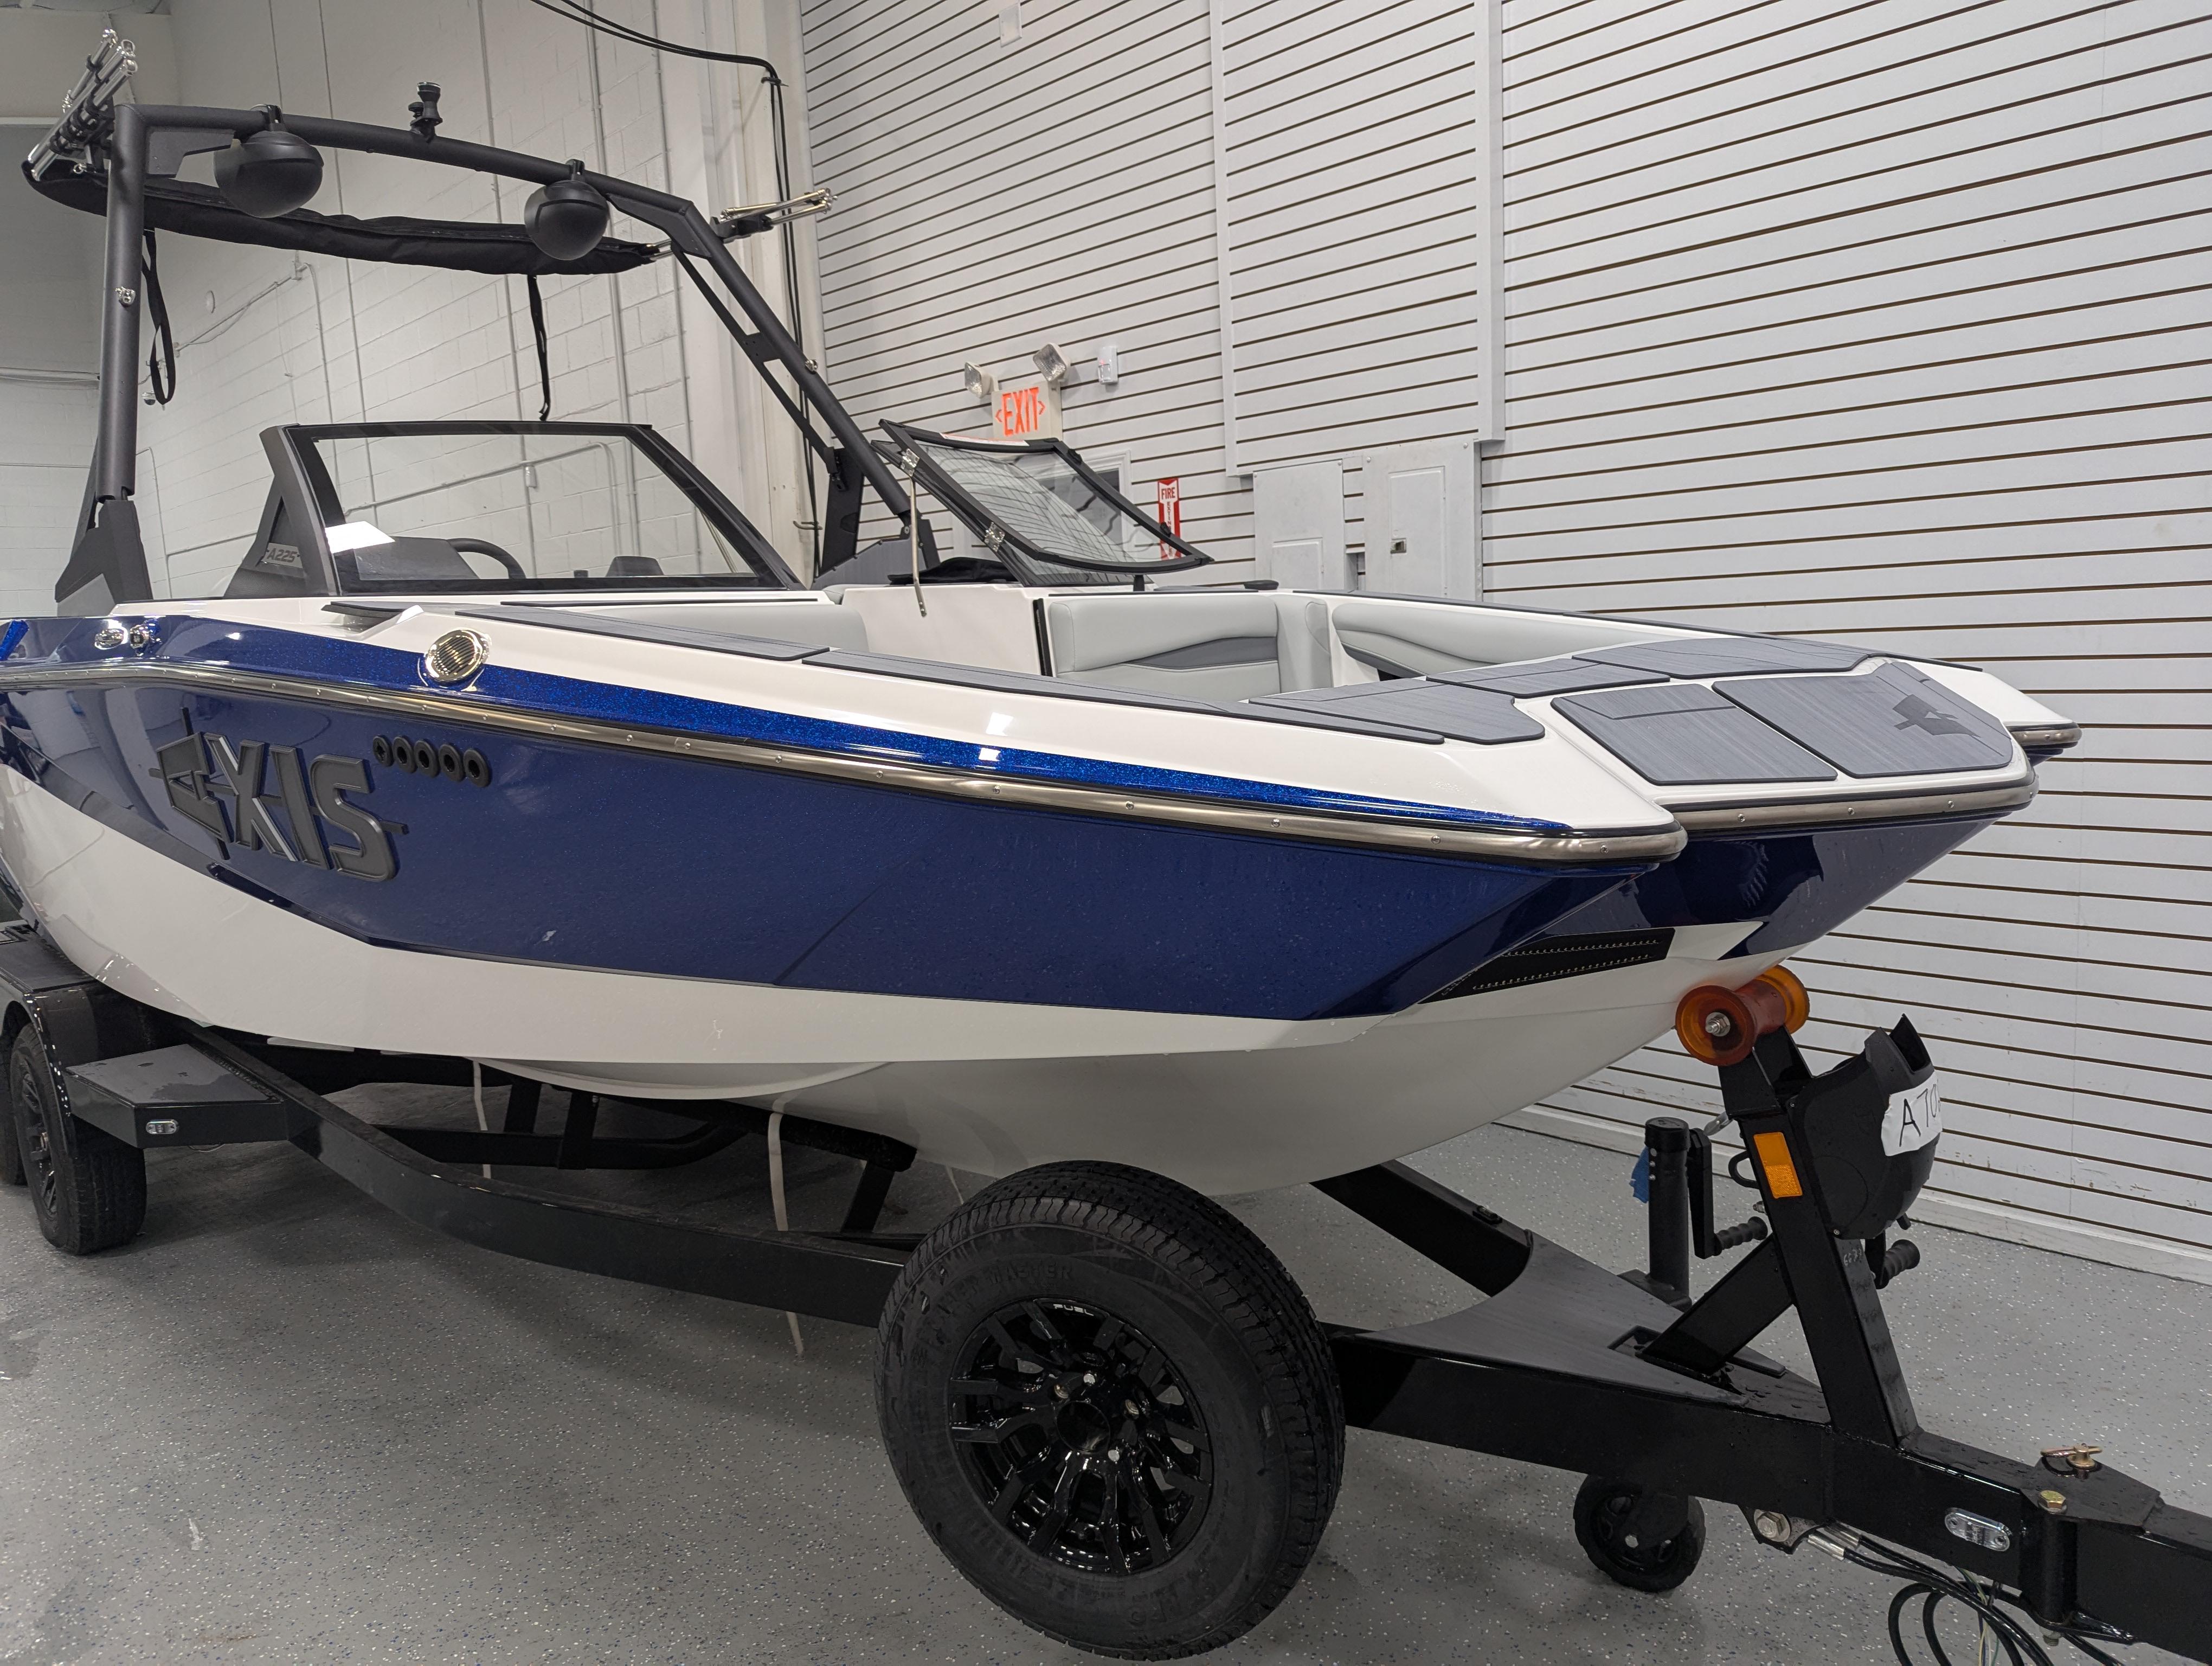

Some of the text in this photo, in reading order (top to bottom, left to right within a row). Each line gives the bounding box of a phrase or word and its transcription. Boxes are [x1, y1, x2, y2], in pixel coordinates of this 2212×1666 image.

[1001, 387, 1039, 437] EXIT
[1161, 488, 1176, 499] FIRE
[266, 548, 298, 563] A225
[156, 730, 400, 882] AXIS
[1053, 1304, 1094, 1317] FUEL
